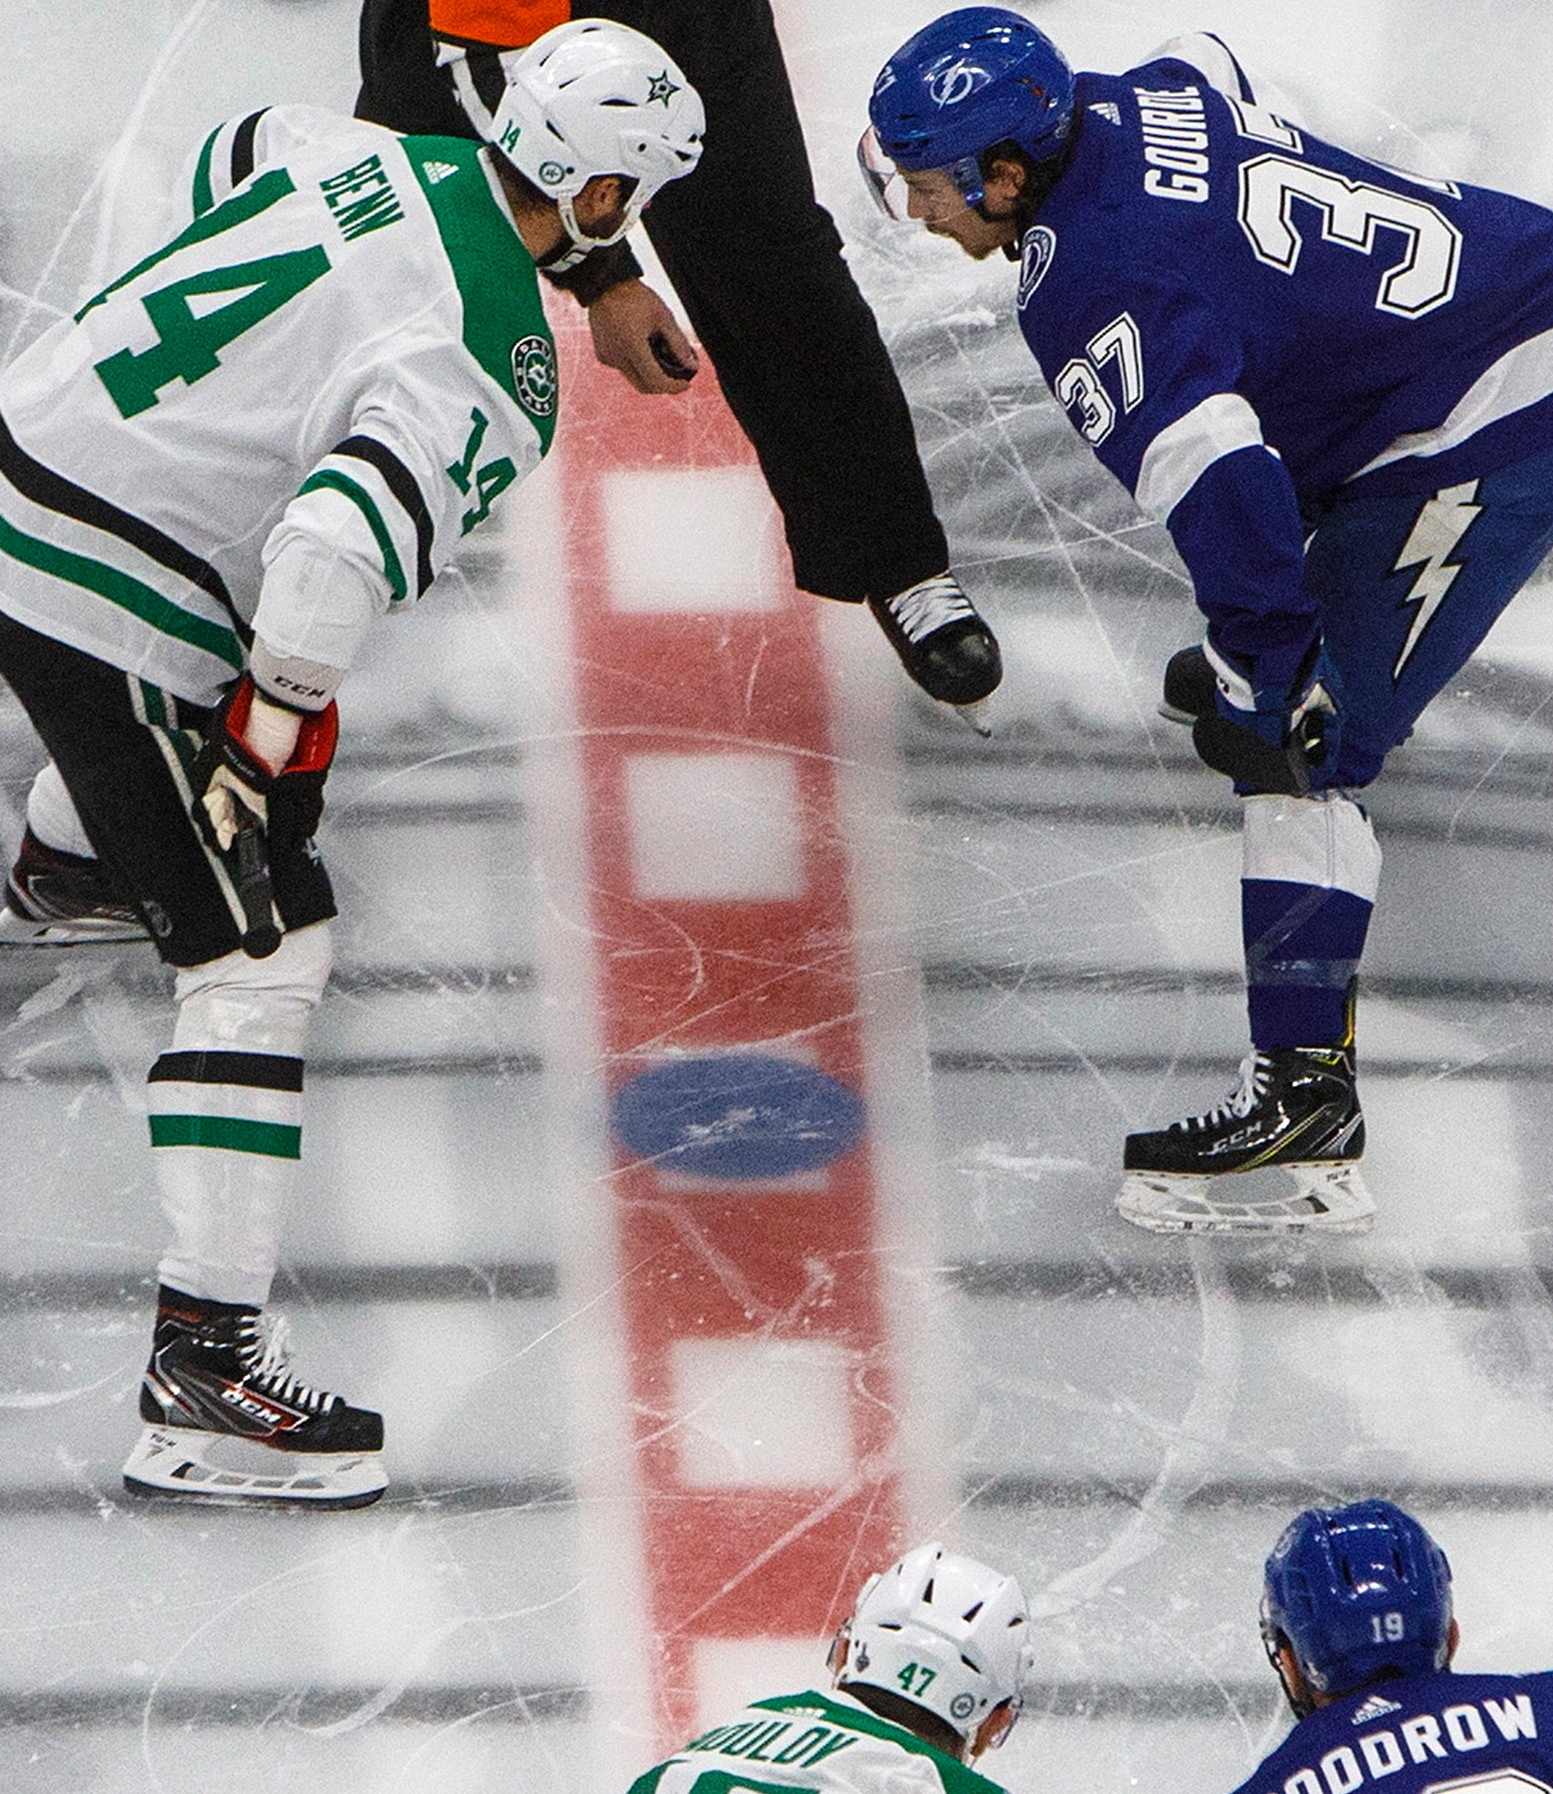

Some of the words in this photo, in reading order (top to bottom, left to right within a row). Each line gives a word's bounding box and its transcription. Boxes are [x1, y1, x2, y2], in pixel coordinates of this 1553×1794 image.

[499, 119, 522, 154] 14
[319, 153, 405, 243] BENN
[73, 167, 333, 421] 14
[1055, 312, 1144, 447] 37
[446, 406, 518, 537] 14
[1212, 1121, 1263, 1154] CCM
[1371, 1612, 1405, 1643] 19
[897, 1662, 939, 1697] 47
[683, 1720, 859, 1768] DULOV
